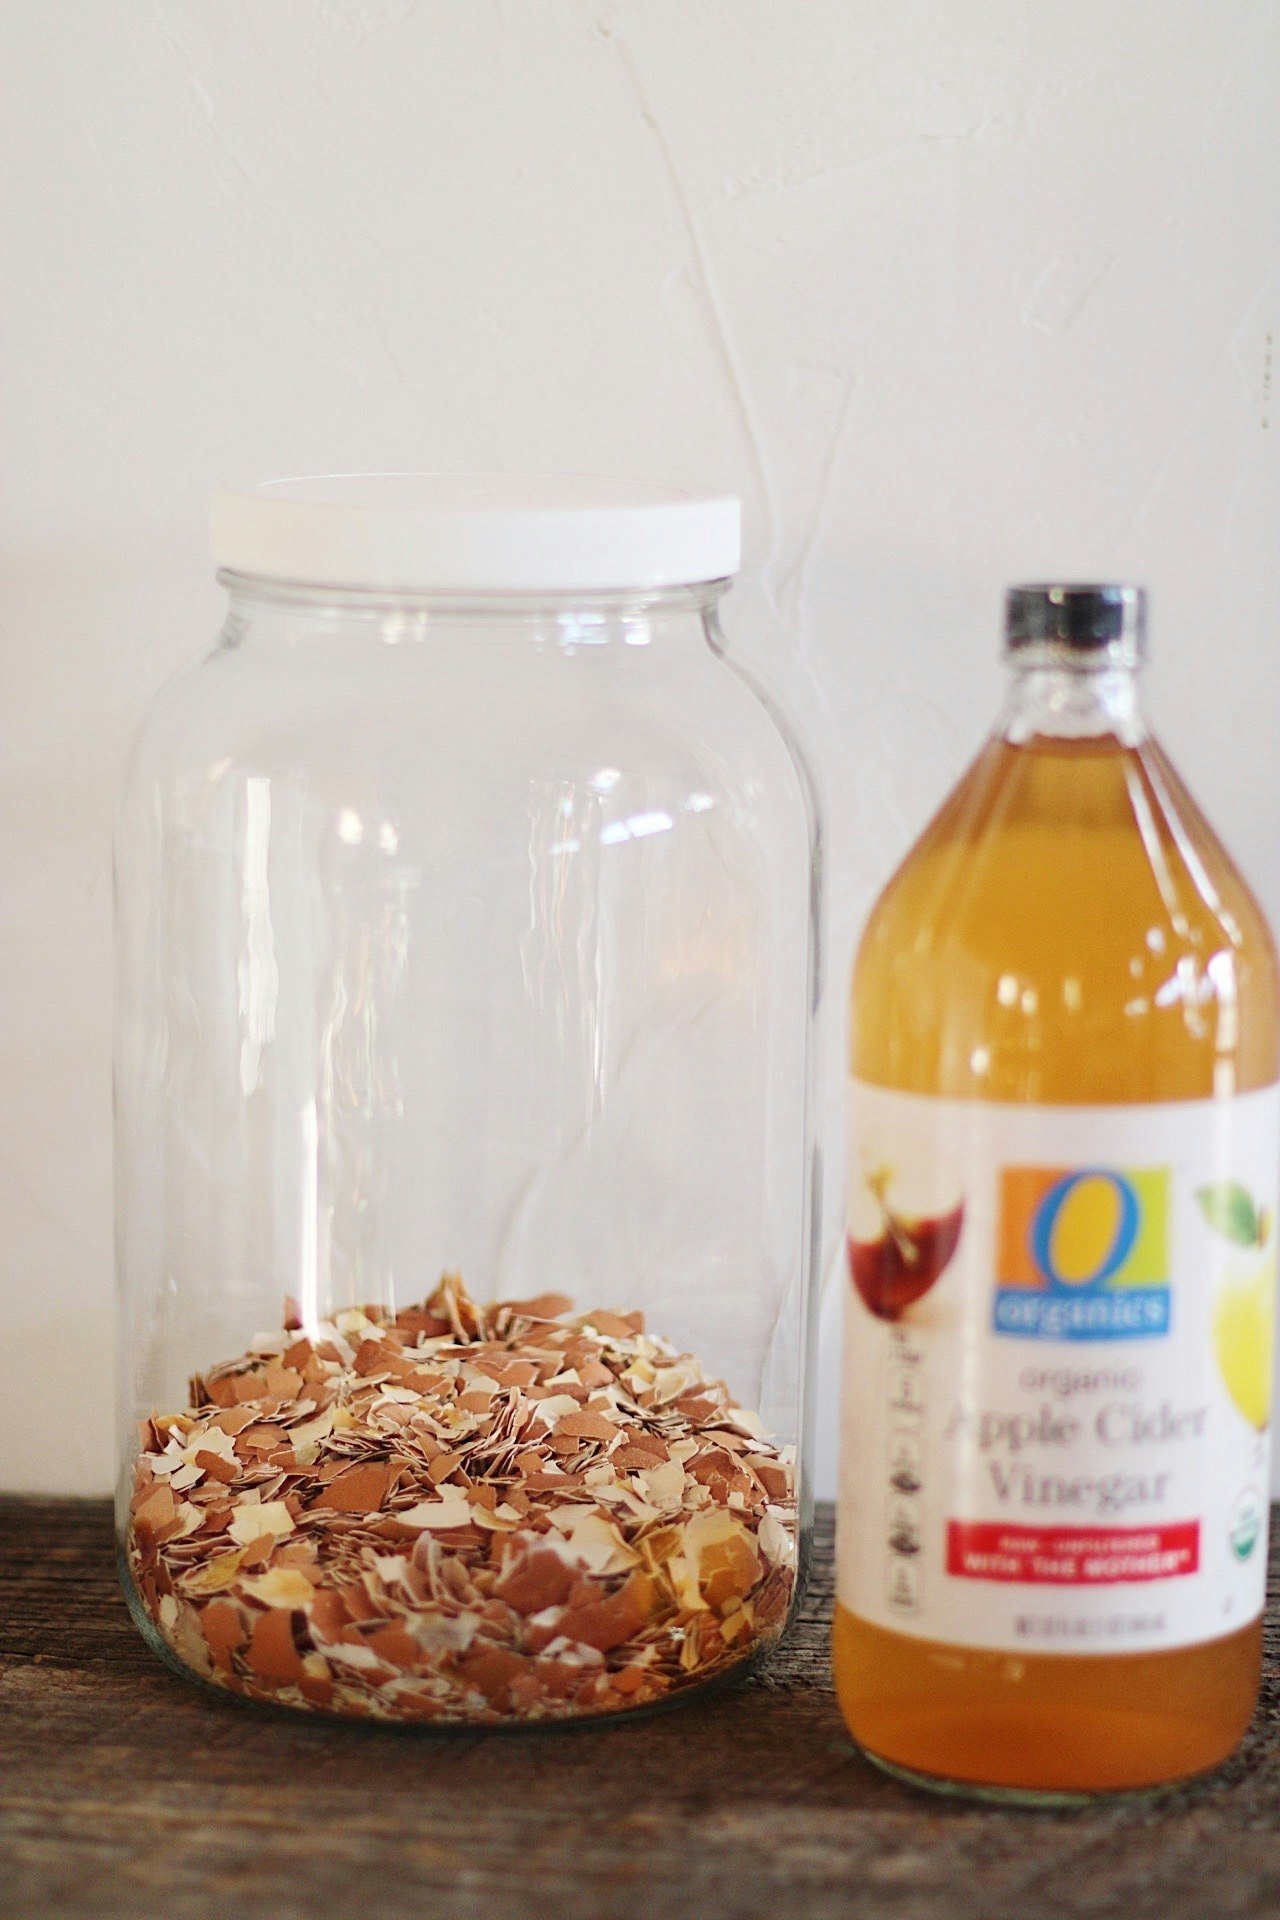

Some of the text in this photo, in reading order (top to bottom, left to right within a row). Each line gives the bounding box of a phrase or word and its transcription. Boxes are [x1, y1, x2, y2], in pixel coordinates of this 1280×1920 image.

[998, 1296, 1165, 1334] organics
[1018, 1366, 1141, 1398] organic
[1095, 1402, 1207, 1446] Cider
[989, 1460, 1168, 1513] Vinegar
